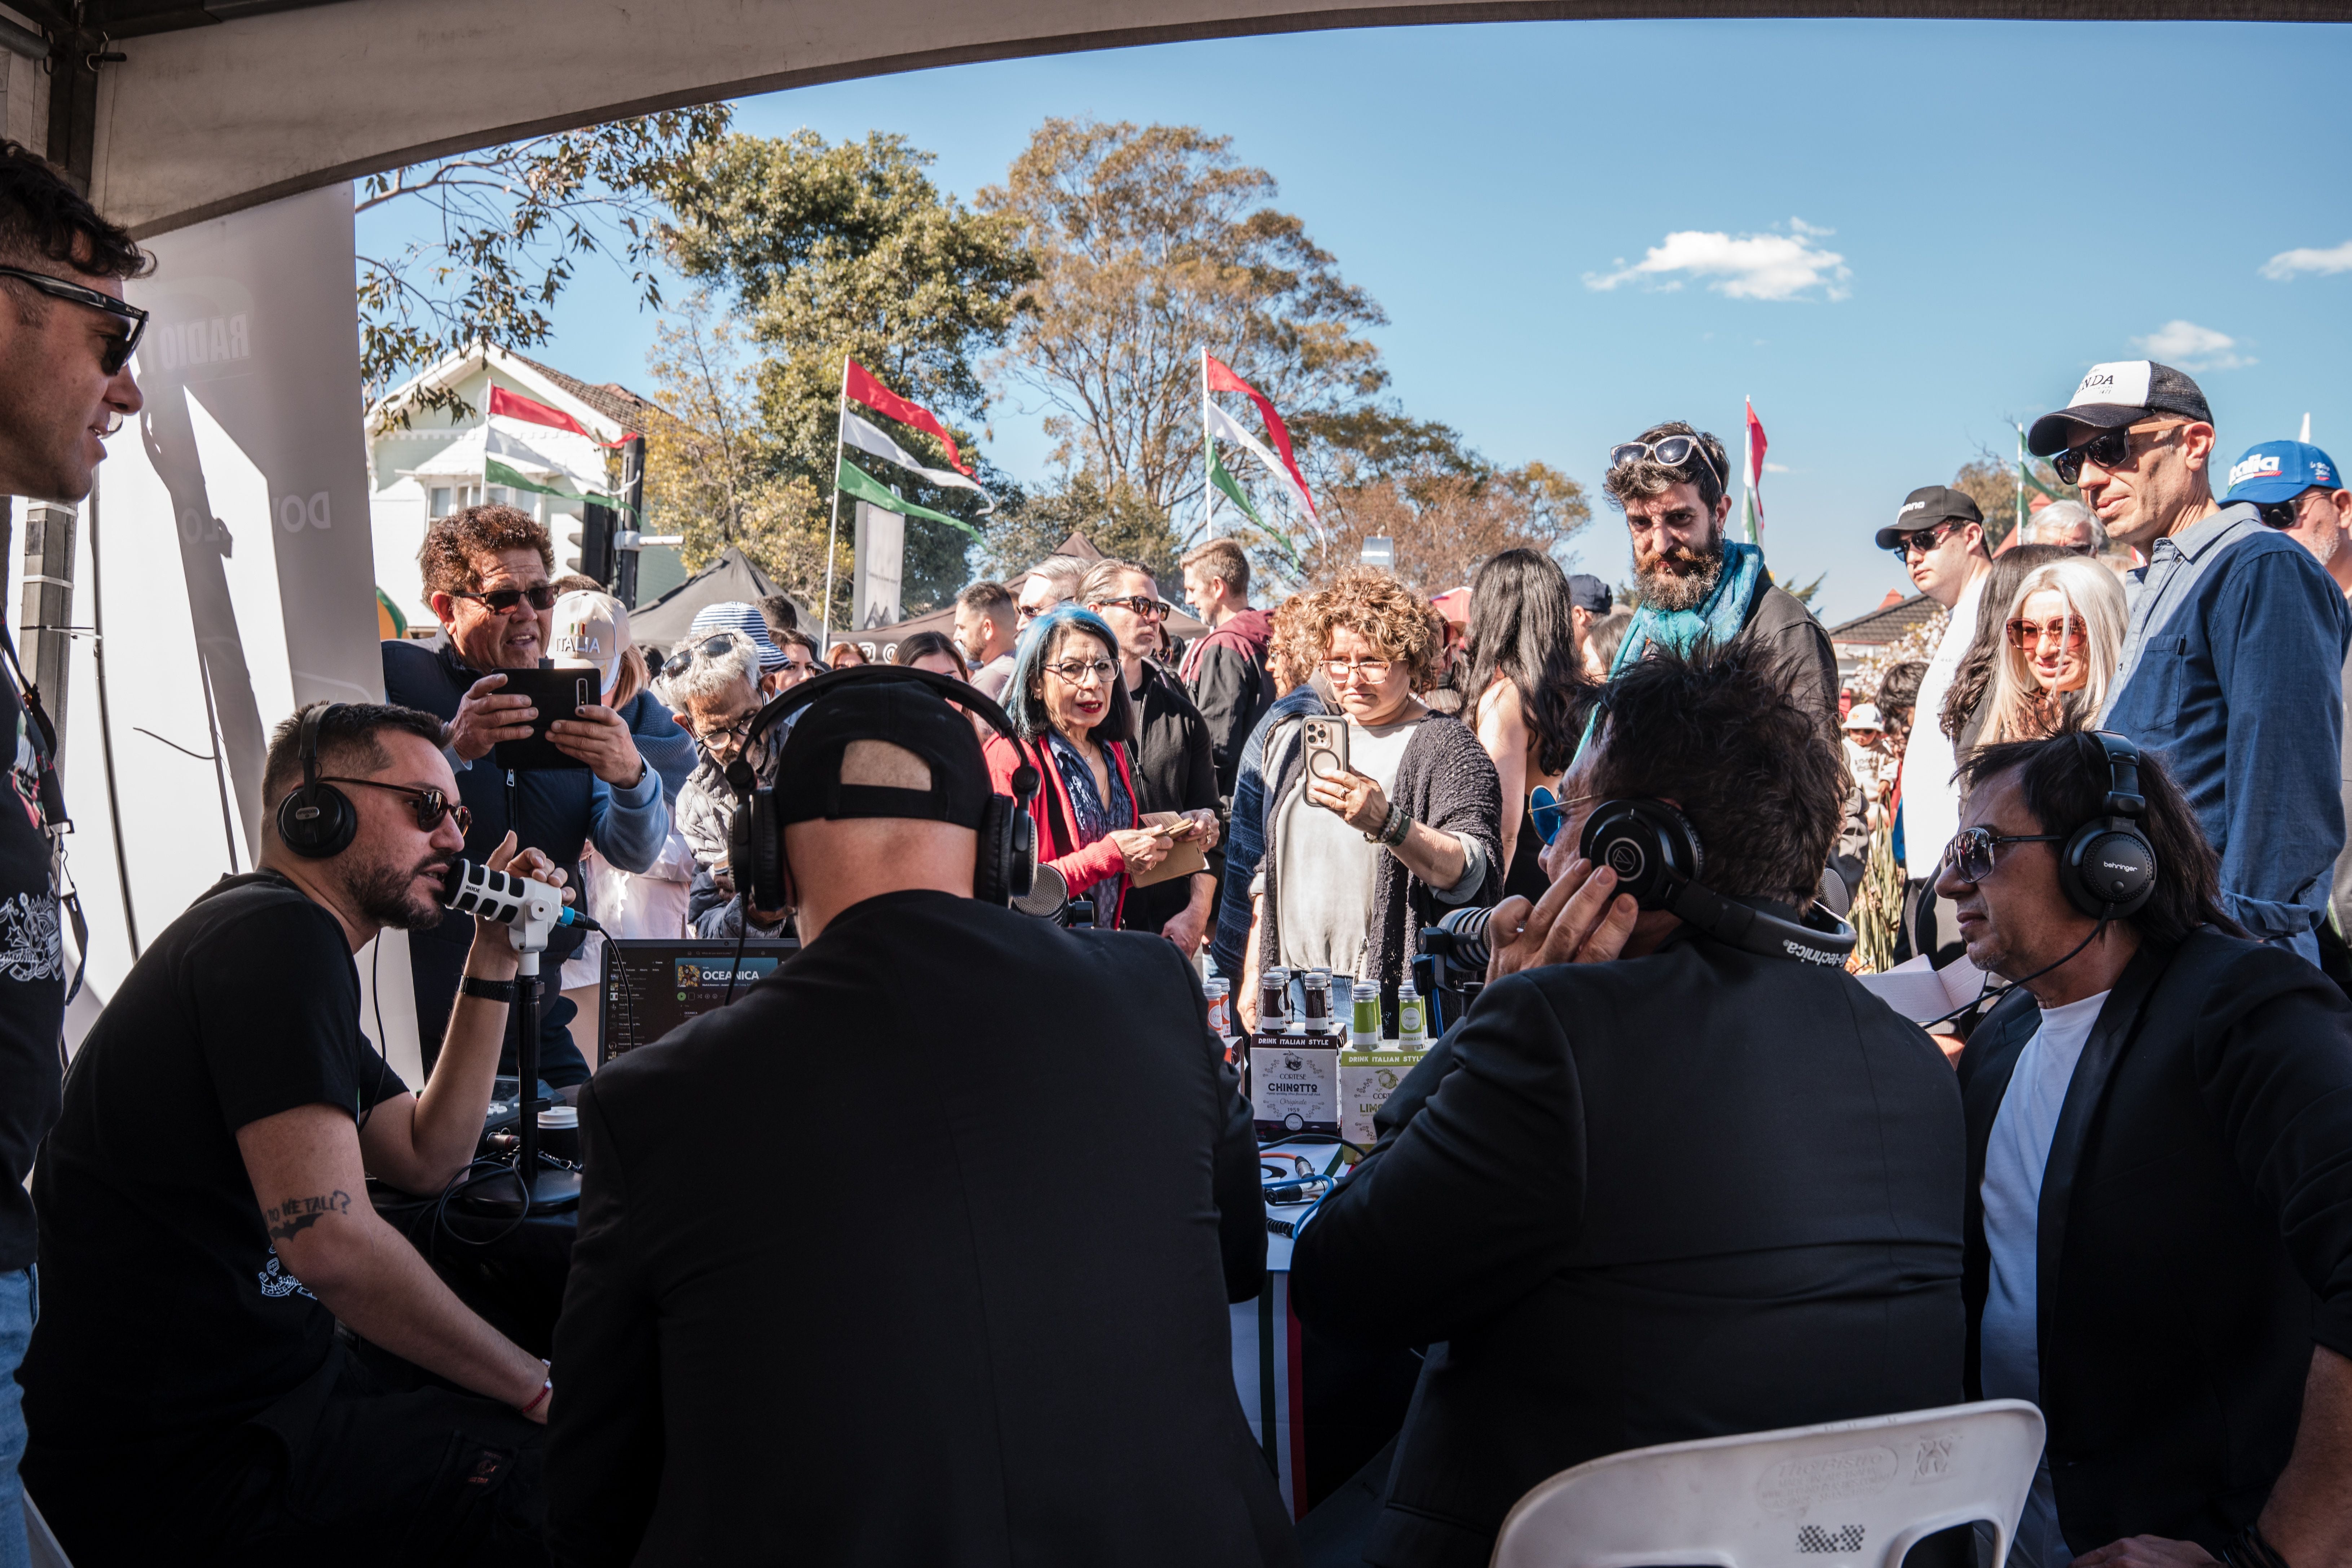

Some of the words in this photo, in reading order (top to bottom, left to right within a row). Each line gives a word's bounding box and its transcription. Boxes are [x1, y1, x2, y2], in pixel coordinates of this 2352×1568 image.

[2076, 375, 2114, 393] NDA
[2229, 454, 2280, 486] talia
[555, 636, 600, 653] ITALIA
[2104, 861, 2137, 872] behringer
[702, 970, 759, 981] OCEANICA
[1268, 1083, 1317, 1093] CHINOTTO
[1280, 1098, 1307, 1106] Originale
[282, 1198, 304, 1216] WE
